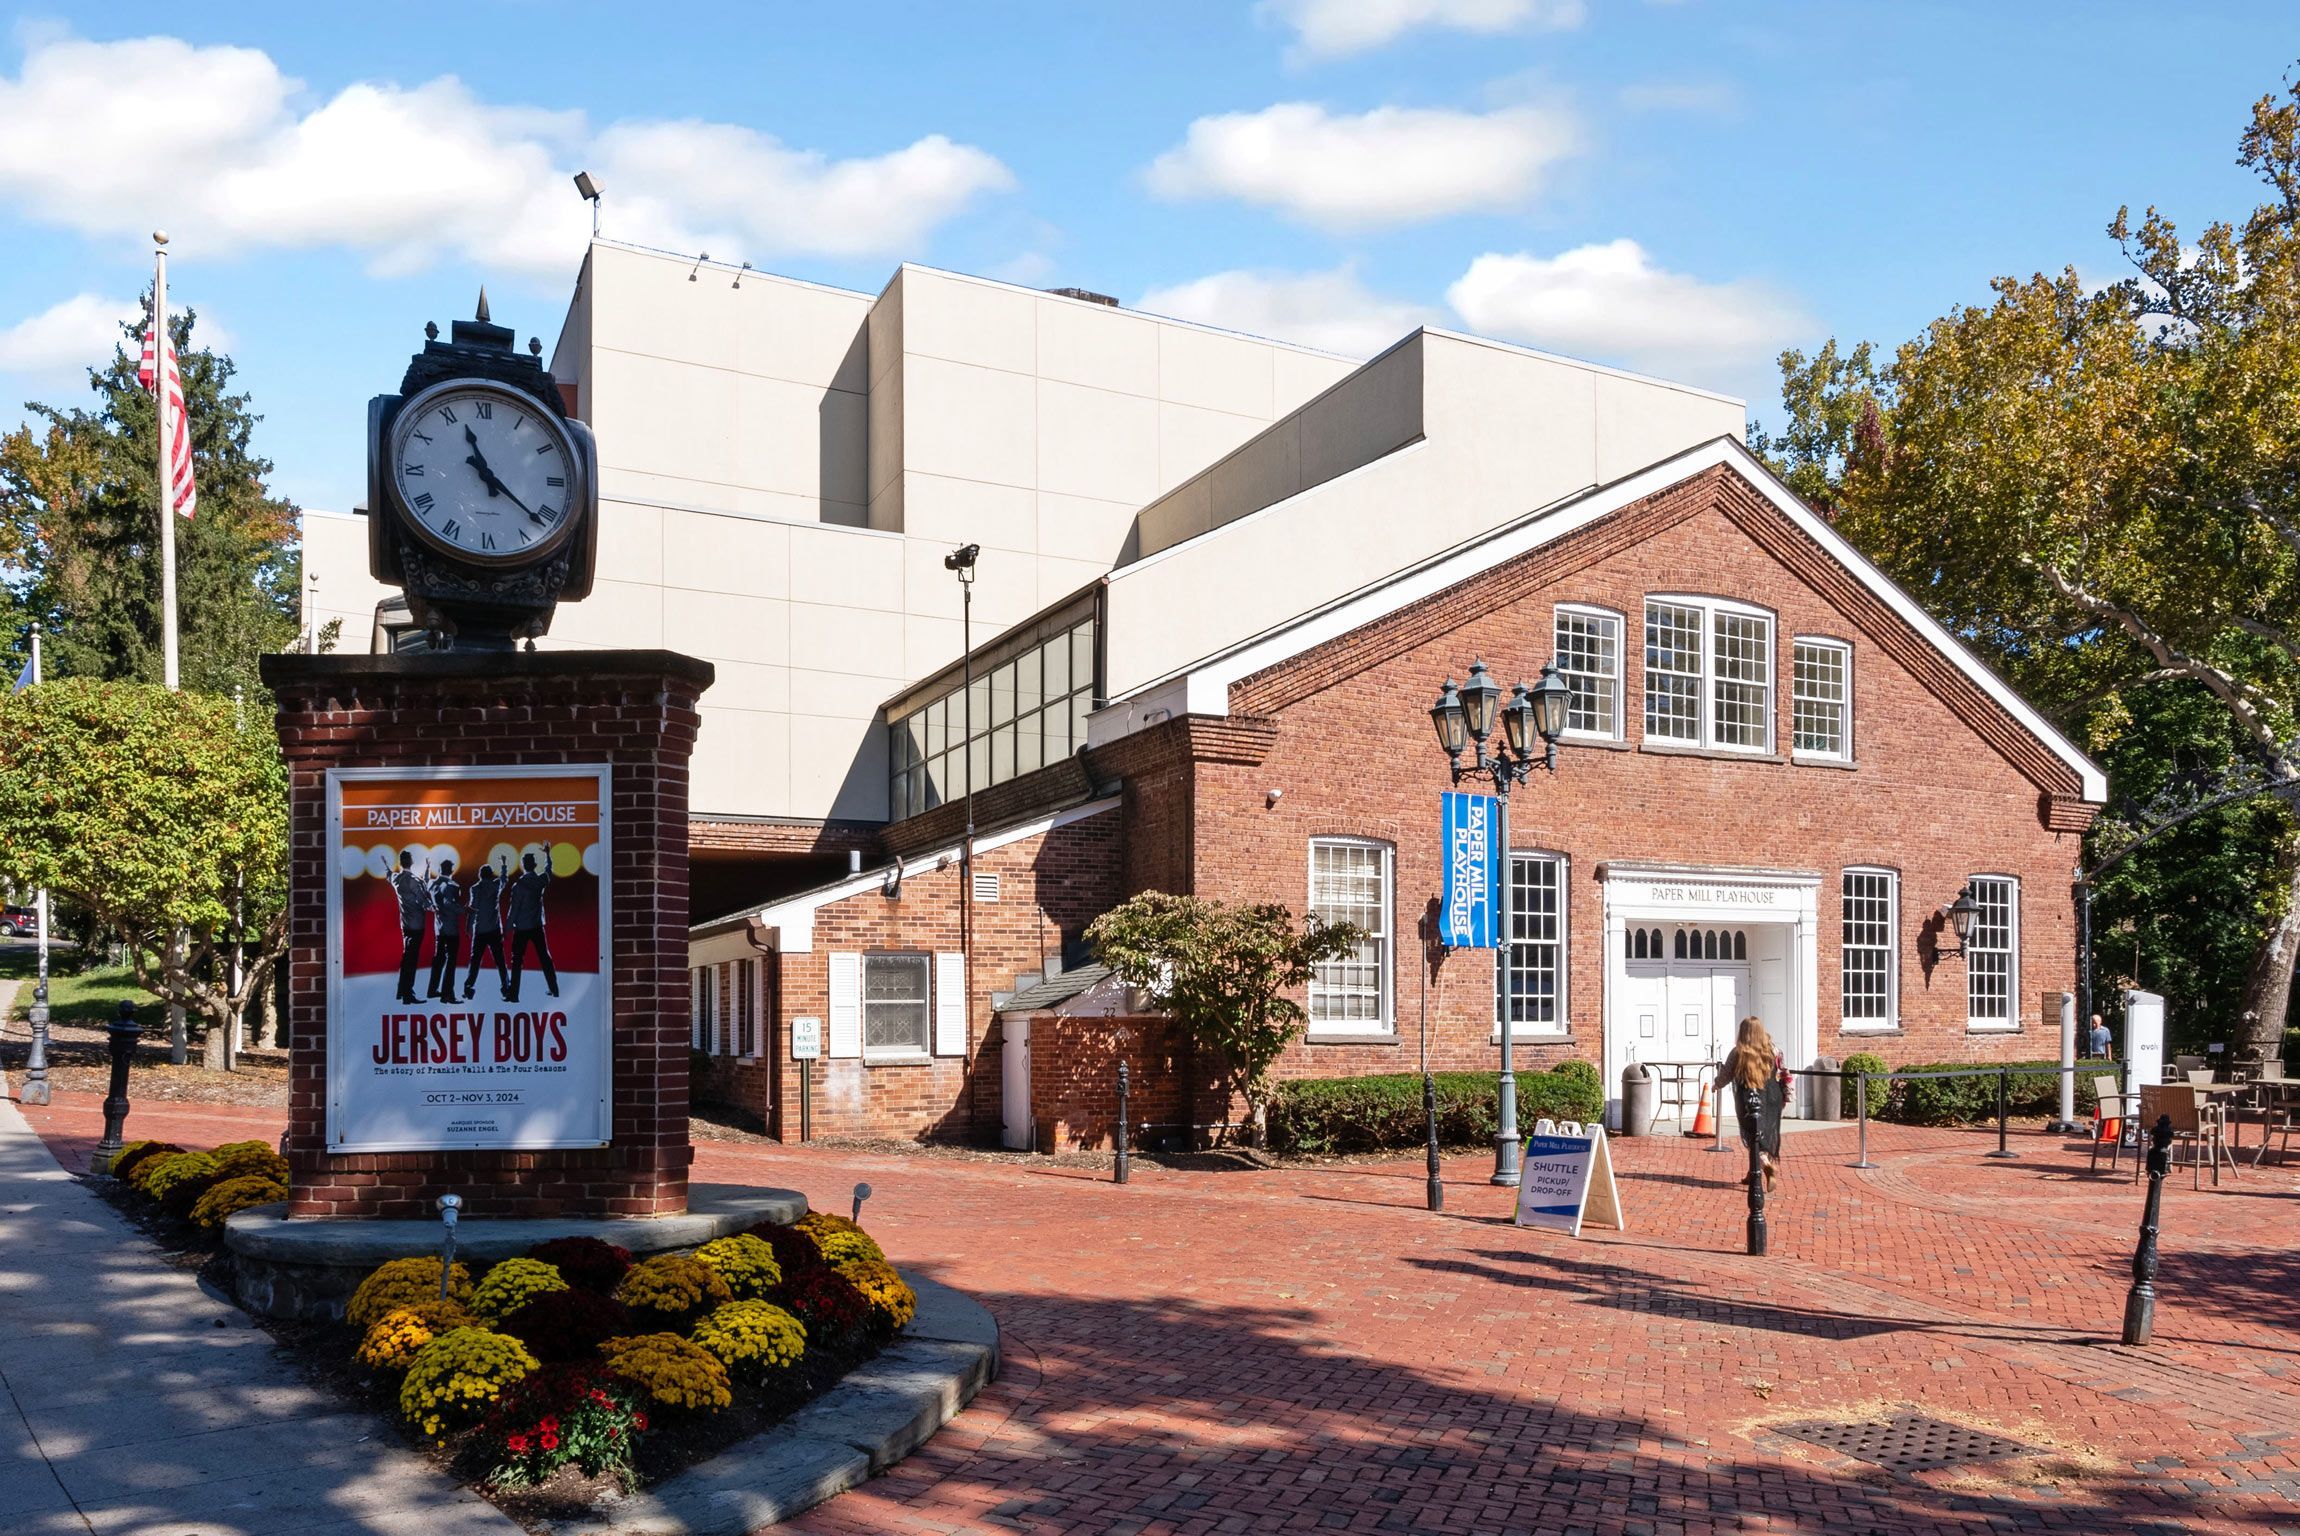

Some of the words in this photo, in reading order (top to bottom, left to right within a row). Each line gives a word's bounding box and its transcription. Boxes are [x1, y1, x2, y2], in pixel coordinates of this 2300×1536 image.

[438, 407, 458, 426] XI
[475, 402, 492, 420] XII
[513, 416, 524, 430] I
[414, 429, 433, 446] X
[536, 443, 553, 455] II
[405, 463, 424, 477] IX
[547, 477, 564, 488] III
[414, 493, 436, 516] VIII
[442, 519, 461, 541] VII
[518, 528, 532, 545] V
[482, 532, 496, 550] VI
[367, 809, 421, 828] PAPER
[426, 805, 465, 828] MILL
[471, 804, 576, 827] PLAYHOUSE
[1468, 806, 1484, 862] PAPER
[1453, 828, 1469, 936] PLAYHOUSE
[1468, 865, 1486, 907] MILL
[1652, 887, 1684, 901] PAPER
[1688, 889, 1712, 902] MILL
[1716, 890, 1775, 904] PLAYHOUSE
[1103, 1007, 1116, 1018] 22
[802, 1022, 812, 1033] 15
[373, 1013, 485, 1064] JERSEY
[494, 1011, 568, 1062] BOYS
[797, 1034, 816, 1042] MINUTE
[796, 1044, 818, 1052] PARKING
[374, 1067, 388, 1075] The
[391, 1067, 414, 1076] story
[428, 1066, 460, 1074] Frankie
[462, 1066, 485, 1074] Valli
[534, 1064, 567, 1072] Seasons
[426, 1094, 446, 1103] OCT
[486, 1094, 494, 1104] 3,
[496, 1093, 519, 1102] 2024
[1533, 1161, 1579, 1174] SHUTTLE
[1537, 1176, 1570, 1187] PICKUP/
[1531, 1186, 1573, 1196] DROP-OFF
